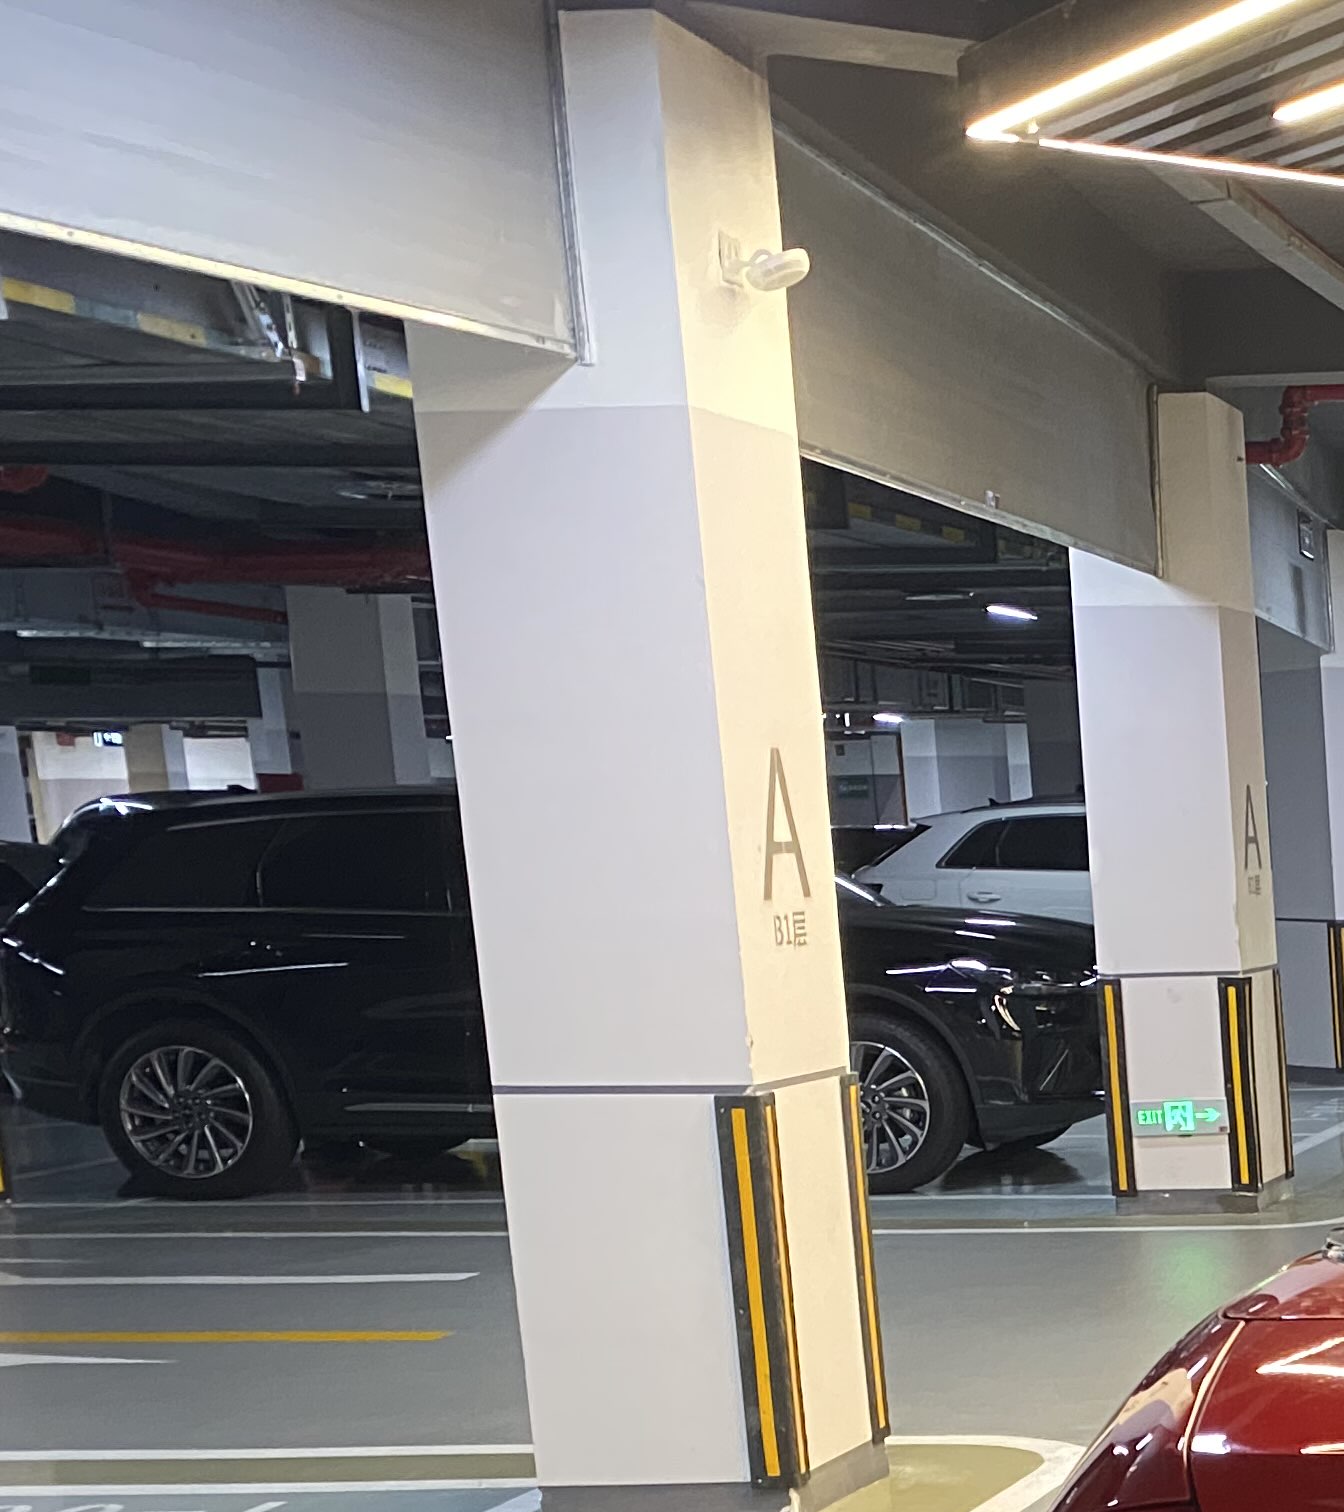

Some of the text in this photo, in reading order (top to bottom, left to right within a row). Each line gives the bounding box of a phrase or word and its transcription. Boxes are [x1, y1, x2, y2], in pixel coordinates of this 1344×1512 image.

[763, 747, 812, 901] A
[1244, 783, 1262, 870] A
[773, 911, 808, 948] B1层
[1137, 1109, 1163, 1125] EXIT
